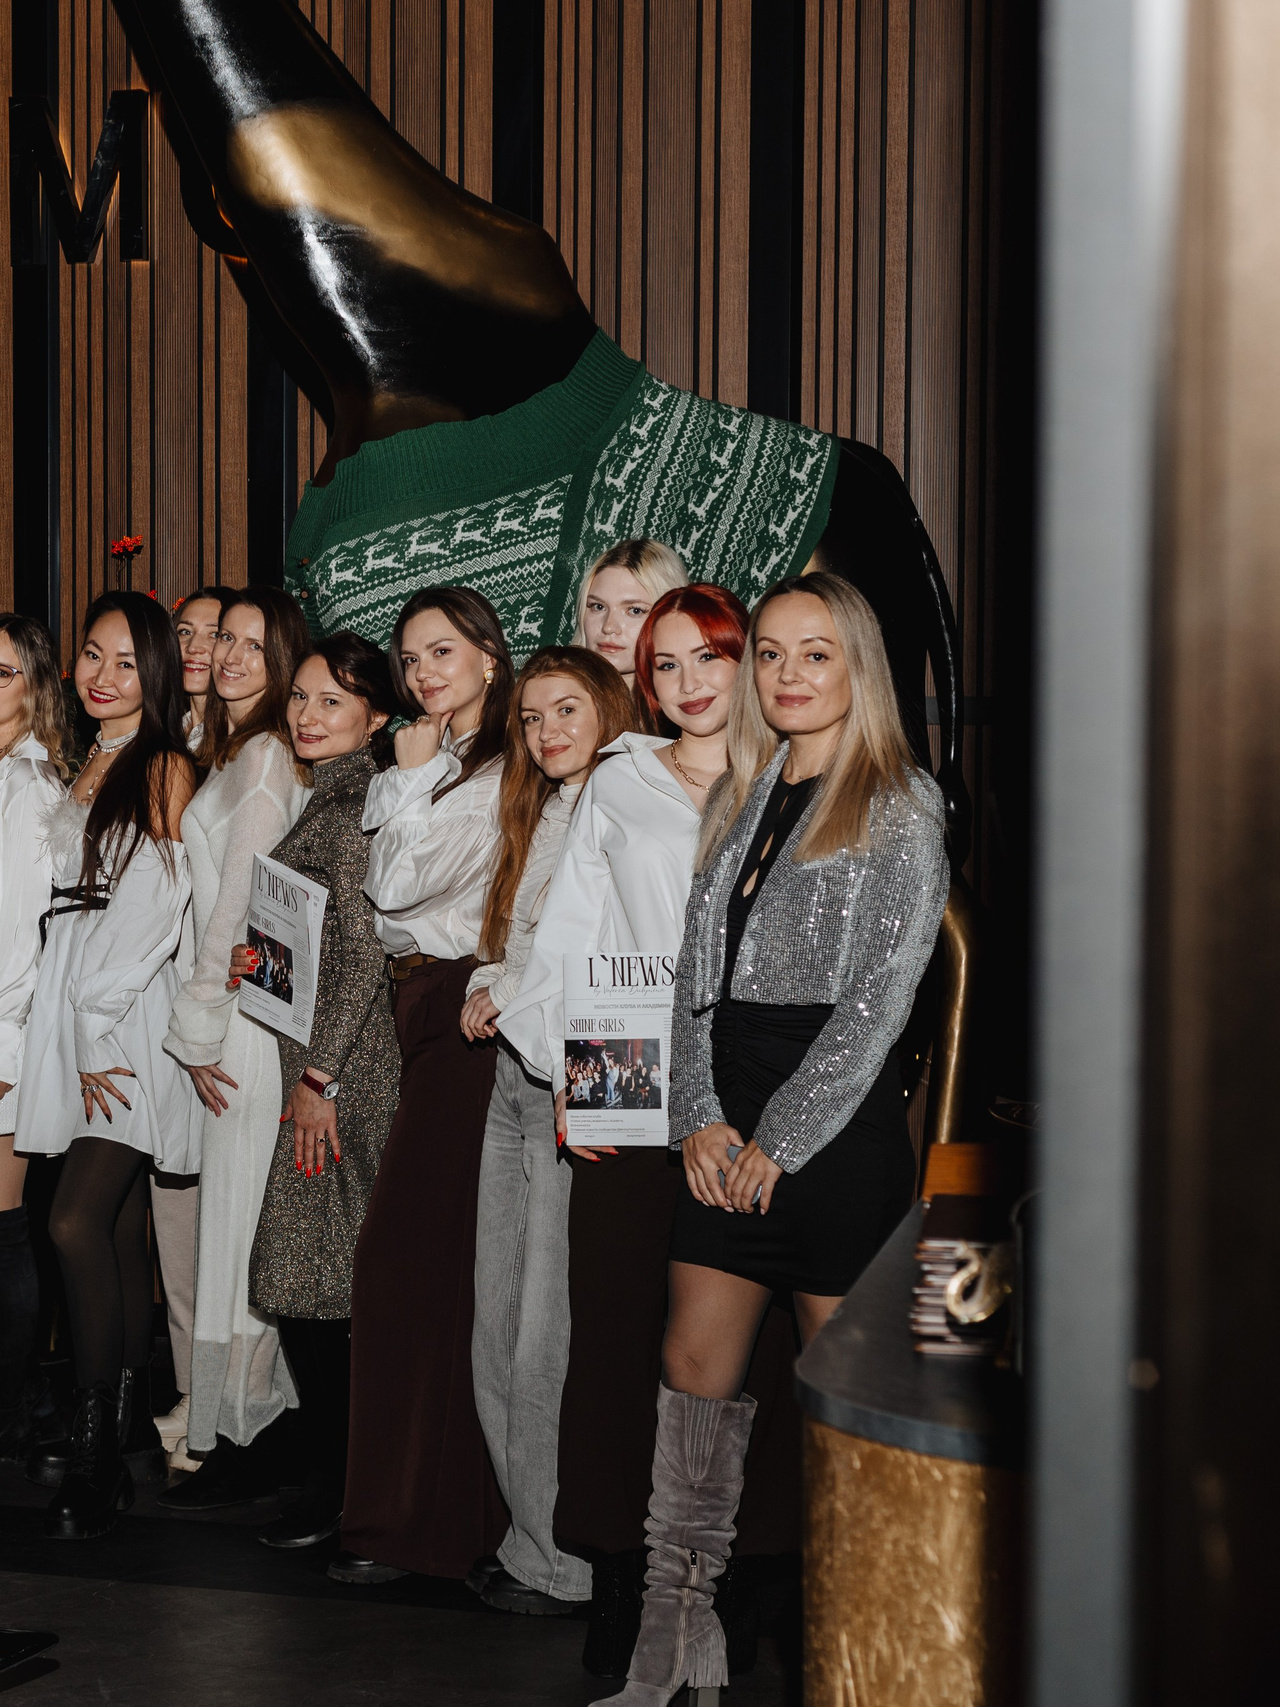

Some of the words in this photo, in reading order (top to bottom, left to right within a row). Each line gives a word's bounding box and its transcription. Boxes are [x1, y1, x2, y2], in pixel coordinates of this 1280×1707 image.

[249, 908, 261, 926] SHINE
[261, 916, 276, 934] GIRLS
[570, 1018, 596, 1033] SHINE
[598, 1018, 625, 1032] GIRLS
